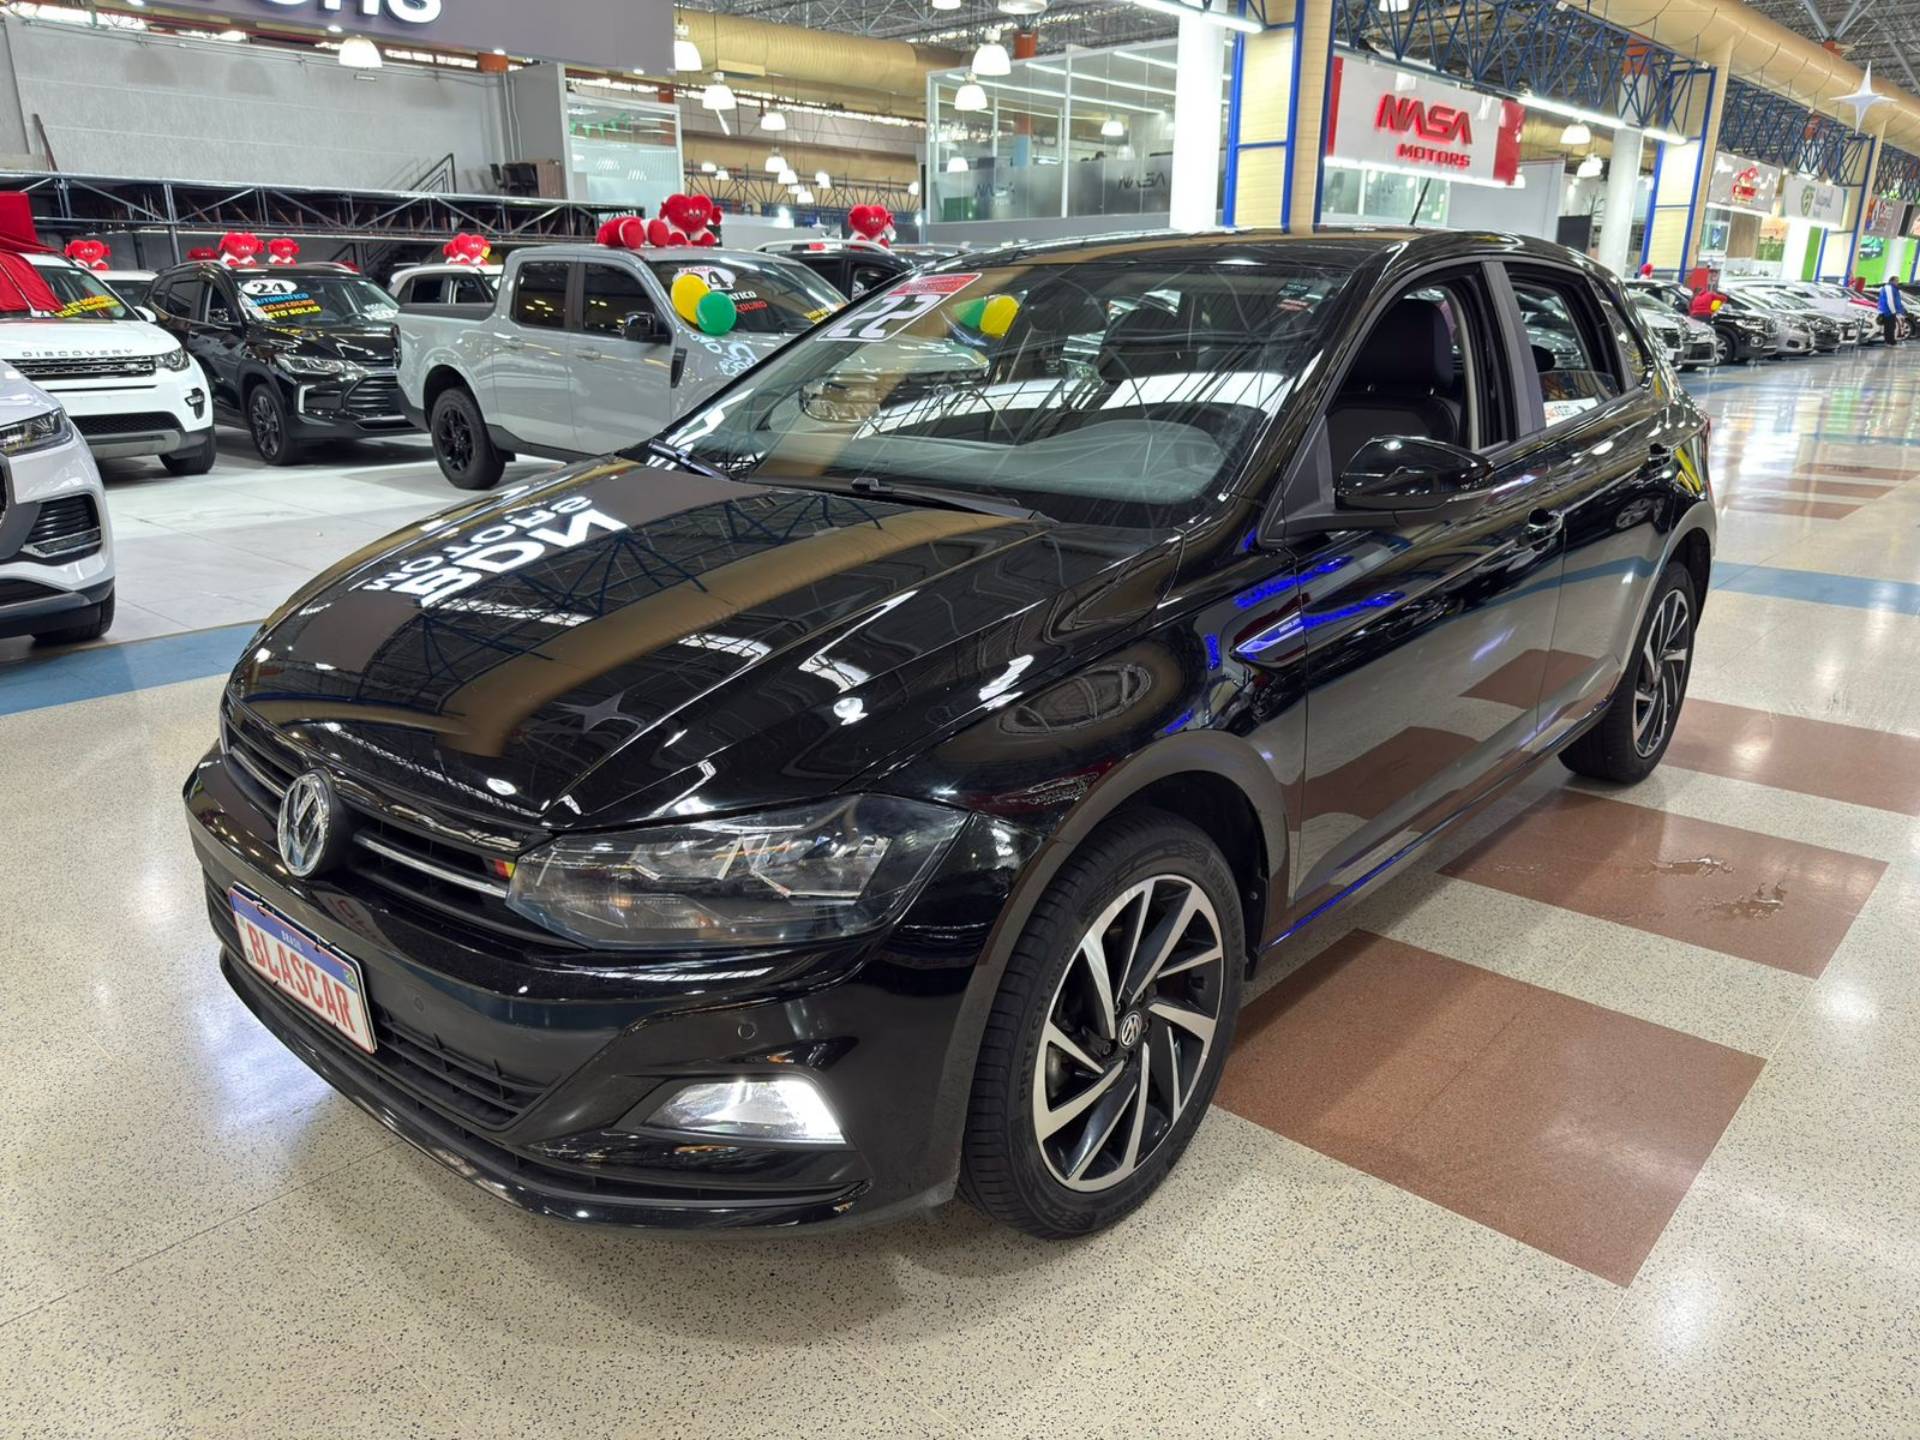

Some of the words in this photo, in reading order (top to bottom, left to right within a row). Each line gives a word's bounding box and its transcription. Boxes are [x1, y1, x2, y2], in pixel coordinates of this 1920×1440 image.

[1376, 93, 1472, 145] NASA
[1397, 143, 1471, 168] MOTORS
[252, 282, 288, 294] 24
[826, 294, 942, 338] 22
[21, 348, 134, 358] DISCOVERY
[246, 922, 356, 1034] BLASCAR
